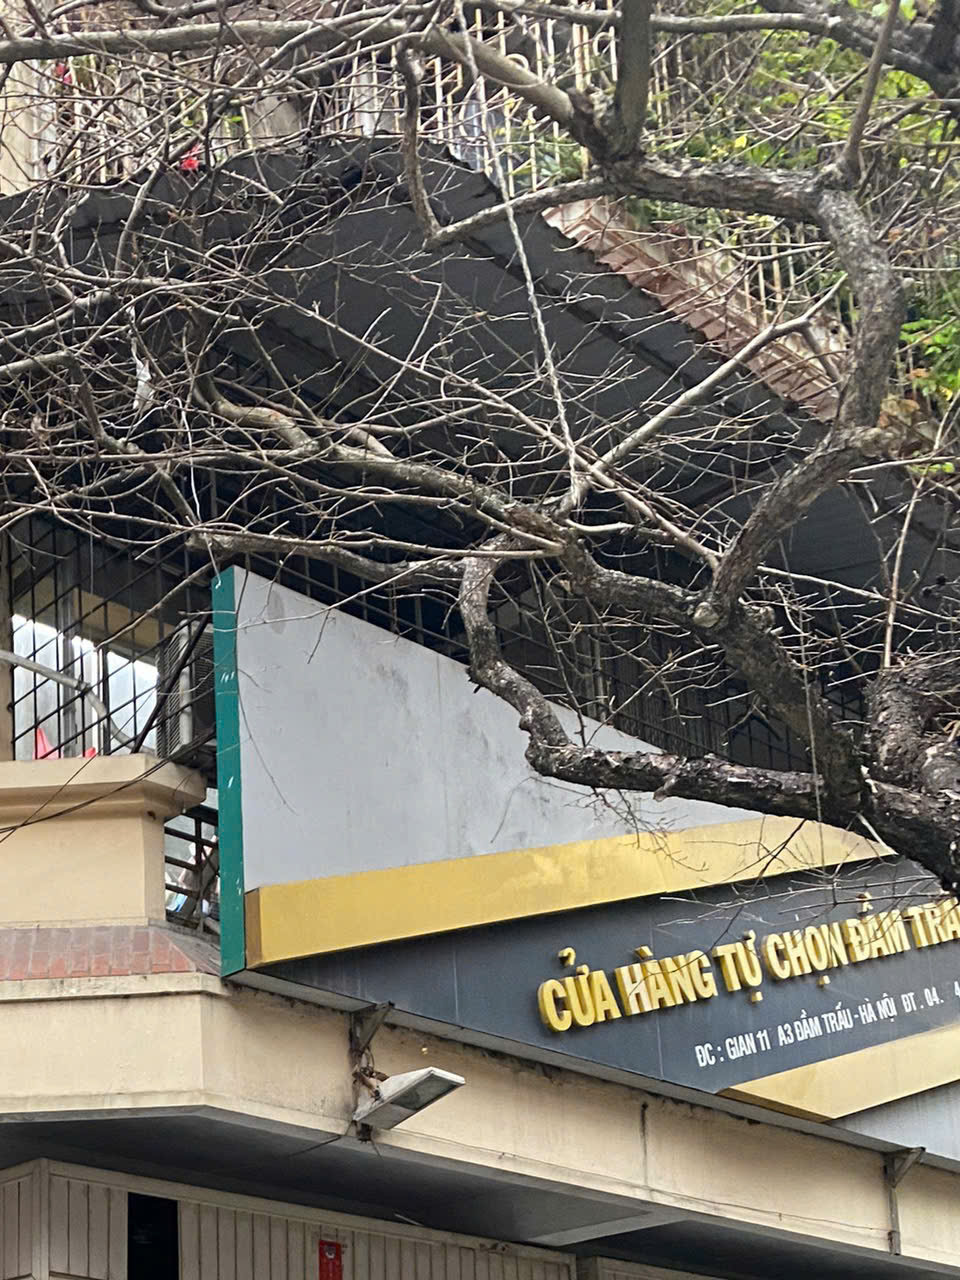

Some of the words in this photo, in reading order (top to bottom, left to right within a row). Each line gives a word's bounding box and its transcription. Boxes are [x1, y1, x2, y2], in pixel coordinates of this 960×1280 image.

[537, 946, 622, 1032] CỬA
[614, 945, 718, 1016] HÀNG
[712, 930, 764, 1003] TỰ
[762, 921, 849, 988] CHỌN
[844, 891, 911, 963] ĐẦM
[694, 1042, 716, 1068] ĐC
[725, 1032, 756, 1060] GIAN
[756, 1030, 772, 1051] 11
[777, 1023, 795, 1047] A3
[794, 1009, 823, 1042] ĐẦM
[822, 1001, 854, 1033] TRẤU
[859, 997, 877, 1025] HÀ
[878, 993, 898, 1023] NỘI
